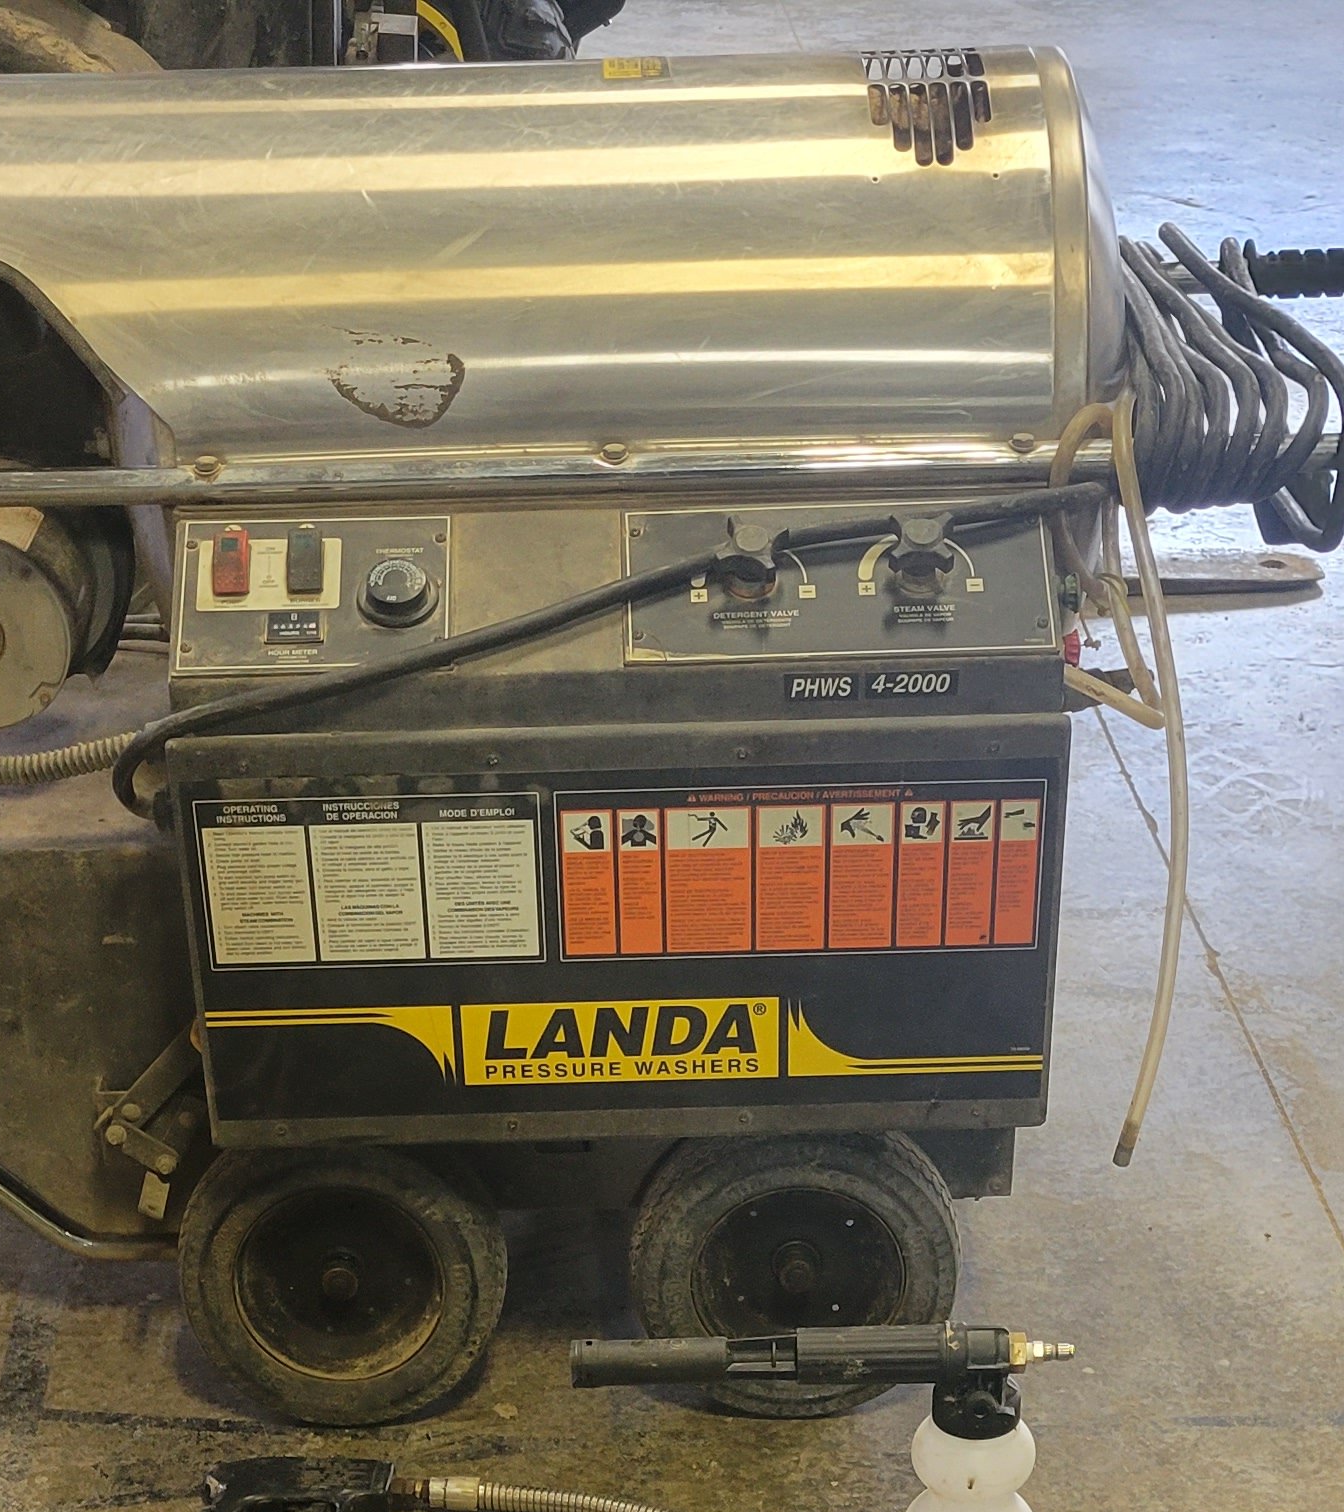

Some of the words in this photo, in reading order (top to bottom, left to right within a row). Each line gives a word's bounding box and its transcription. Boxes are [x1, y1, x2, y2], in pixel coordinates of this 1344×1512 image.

[893, 604, 925, 613] STEAM
[926, 604, 956, 612] VALVE
[713, 610, 768, 620] DETERGENT
[770, 609, 800, 617] VALVE
[291, 648, 318, 656] METER
[790, 676, 853, 698] PHWS
[871, 673, 951, 694] 4-2000
[699, 793, 744, 802] WARNING
[822, 788, 901, 799] AVERTISSEMENT
[222, 804, 279, 814] OPERATING
[322, 801, 400, 812] INSTRUCCIONES
[326, 812, 339, 821] DE
[342, 811, 398, 820] OPERACION
[439, 808, 468, 818] MODE
[470, 807, 515, 817] D'EMPLOI
[216, 813, 287, 824] INSTRUCTIONS
[484, 1061, 622, 1080] PRESSURE
[635, 1058, 760, 1076] WASHERS
